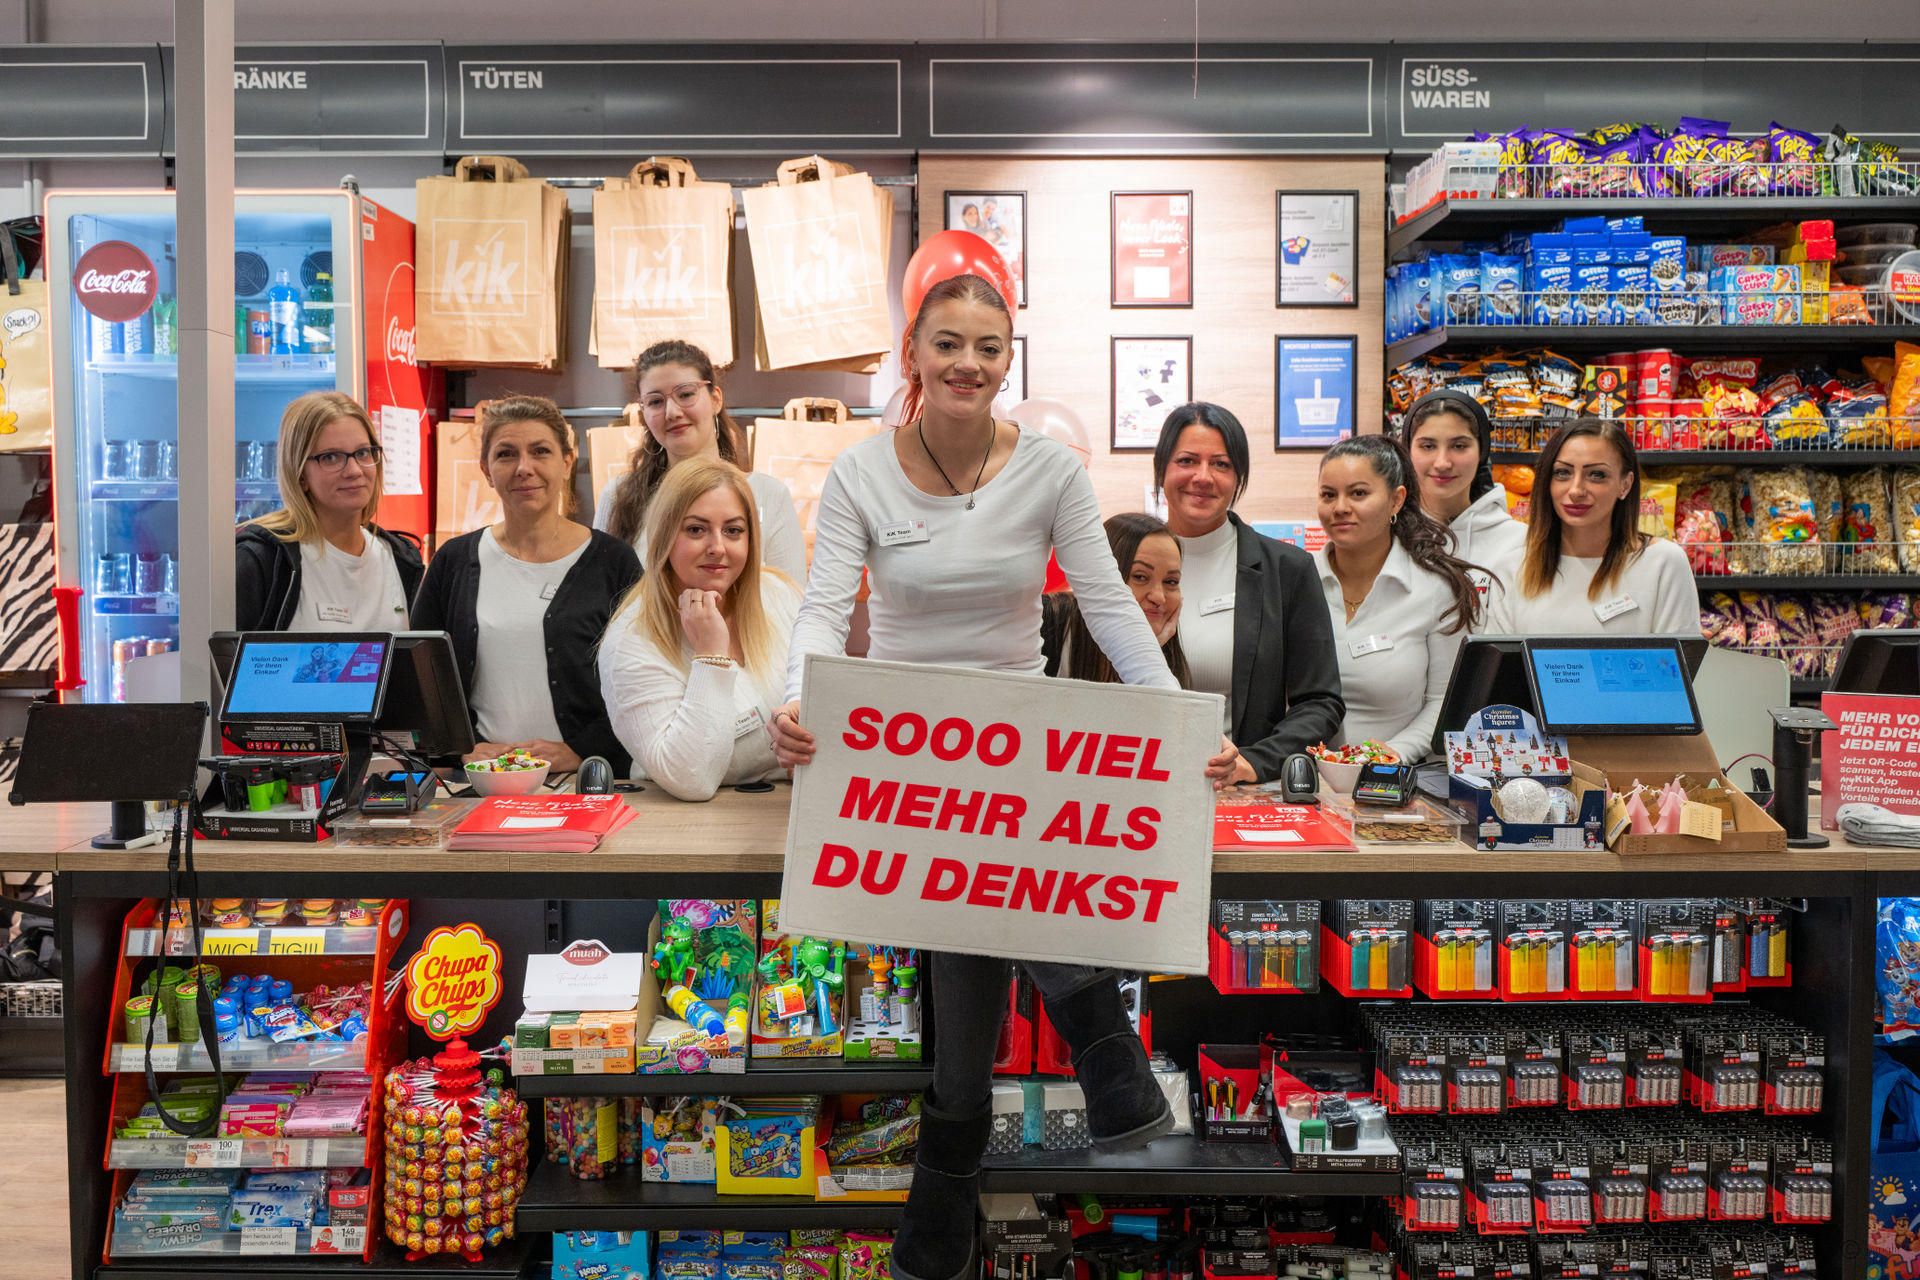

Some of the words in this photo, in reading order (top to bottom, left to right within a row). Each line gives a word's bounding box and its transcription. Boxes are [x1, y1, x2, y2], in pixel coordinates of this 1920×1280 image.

[470, 67, 544, 90] TÜTEN
[1411, 65, 1478, 88] SÜSS-
[1411, 89, 1491, 109] WAREN
[1652, 239, 1683, 251] OREO
[1540, 266, 1572, 278] OREO
[1578, 266, 1610, 278] OREO
[1616, 266, 1648, 278] OREO
[1736, 273, 1773, 287] CRISPY
[1743, 281, 1769, 293] CUPS
[1738, 300, 1775, 315] CRISPY
[1840, 711, 1891, 725] MEHR
[1896, 713, 1920, 726] VO
[1840, 722, 1875, 737] FÜR
[1879, 726, 1920, 740] DICH
[841, 706, 1021, 767] SOOO
[1045, 729, 1172, 782] VIEL
[1839, 738, 1902, 752] JEDEM
[1840, 756, 1866, 765] Jetzt
[1868, 757, 1918, 768] QR-Code
[1840, 767, 1887, 777] scannen,
[1876, 777, 1899, 787] App
[1840, 783, 1914, 796] herunterladen
[1840, 792, 1880, 803] Vorteile
[838, 775, 1028, 839] MEHR
[1038, 800, 1162, 852] ALS
[811, 843, 908, 895] DU
[919, 857, 1180, 924] DENKST
[569, 948, 603, 958] muah
[424, 954, 489, 982] Chupa
[421, 978, 487, 1012] Chups
[153, 1173, 207, 1181] DRAGEES
[249, 1203, 284, 1217] Trex
[147, 1222, 202, 1239] DRAGEES
[161, 1234, 203, 1249] CHEWY
